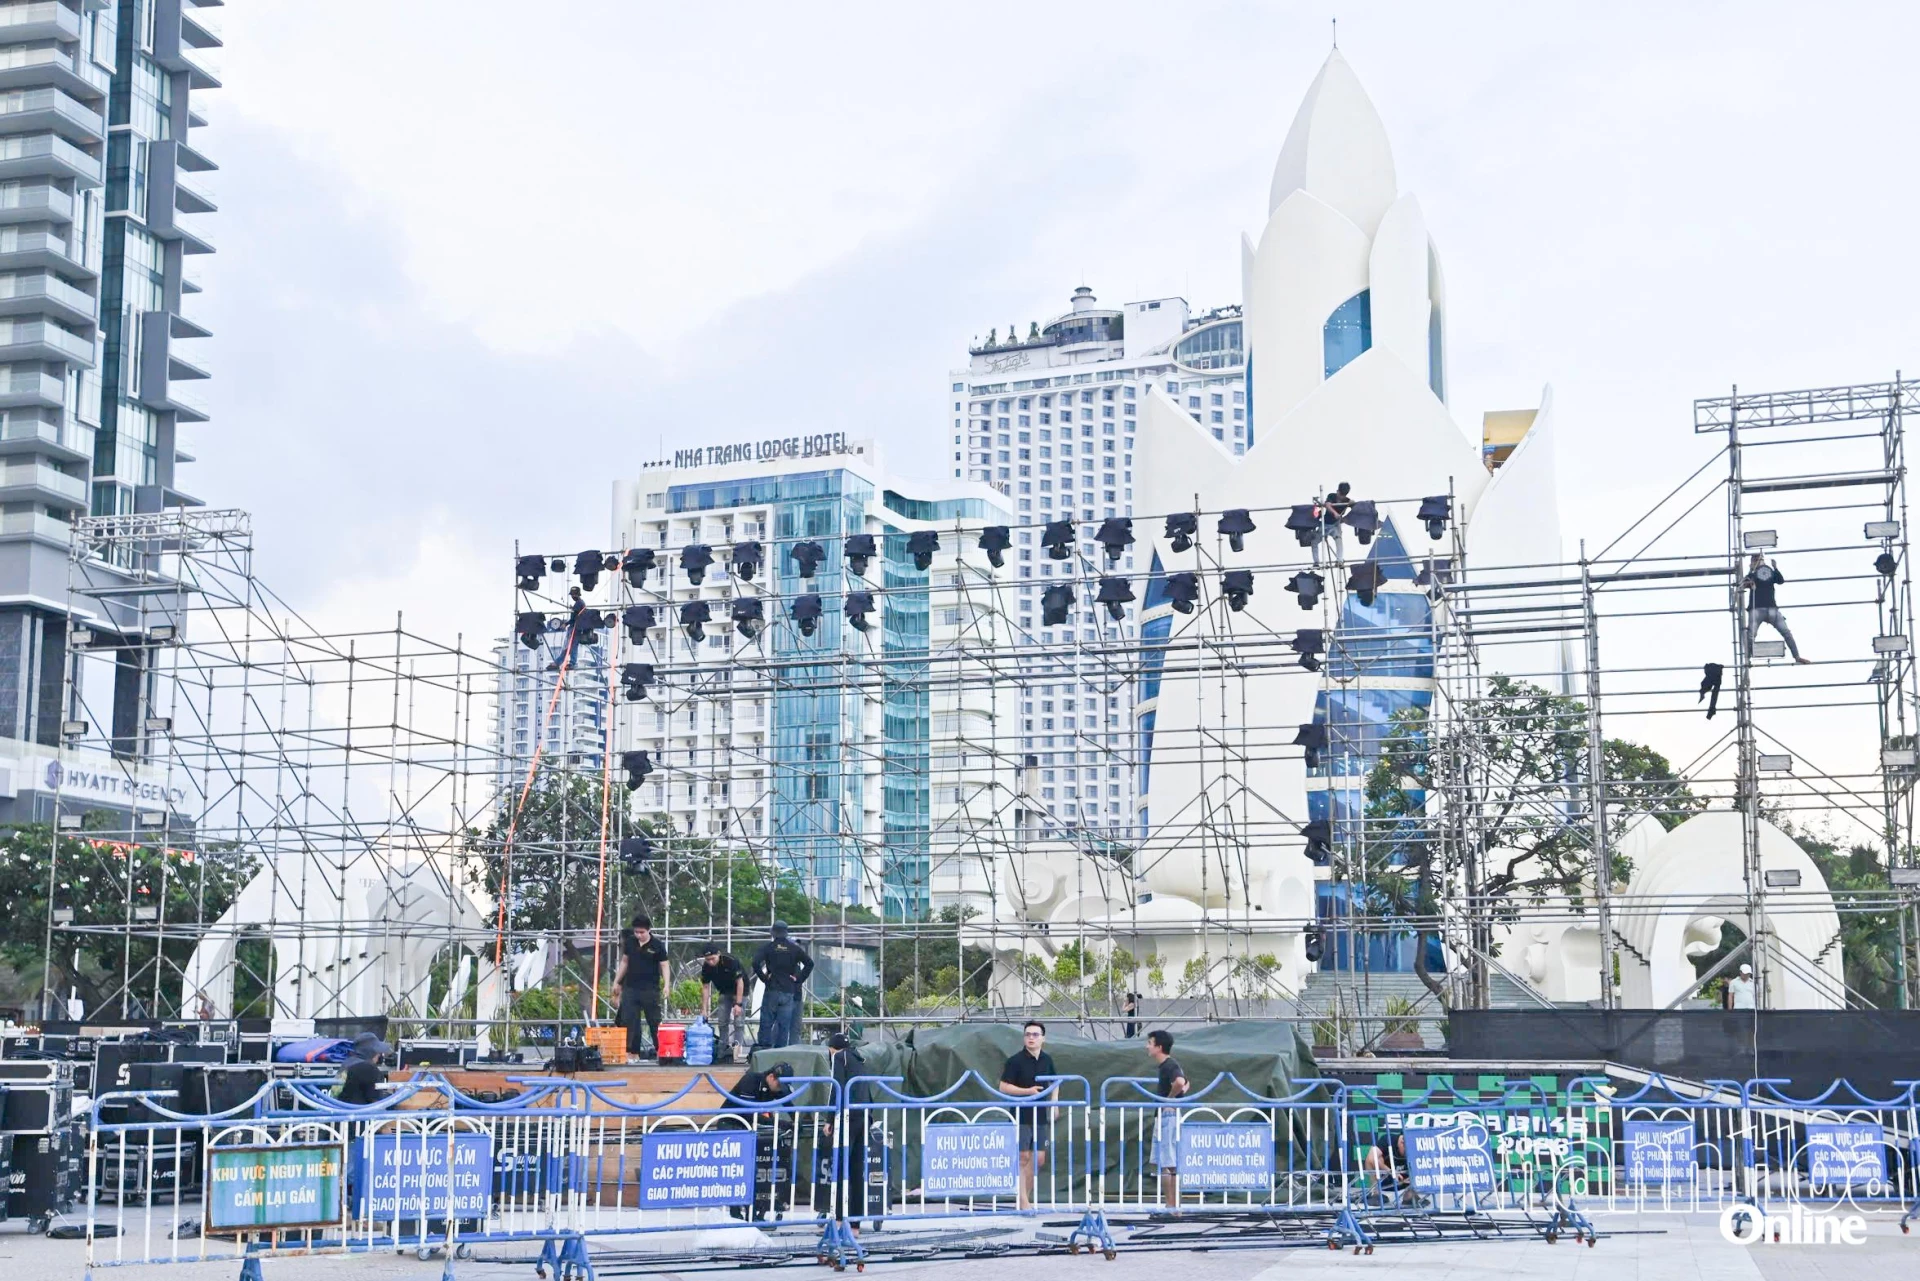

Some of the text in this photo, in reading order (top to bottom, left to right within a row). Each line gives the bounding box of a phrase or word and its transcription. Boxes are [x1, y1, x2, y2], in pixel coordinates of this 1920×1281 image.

[675, 431, 848, 469] NHA TRANG LODGE HOTEL
[68, 770, 187, 805] HYATT REGENCY
[937, 1130, 1005, 1152] KHU VỰC CẤM
[1191, 1135, 1211, 1148] KHU
[1238, 1130, 1261, 1148] CẤM
[1415, 1137, 1435, 1152] KHU
[657, 1137, 741, 1161] KHU VỰC CẤM
[931, 1154, 1010, 1170] CÁC PHƯƠNG TIỆN
[1186, 1152, 1265, 1168] CÁC PHƯƠNG TIỆN
[1415, 1155, 1433, 1169] CÁC
[212, 1157, 338, 1183] KHU VỰC NGUY HIỂM
[653, 1162, 744, 1180] CÁC PHƯƠNG TIỆN
[1183, 1174, 1200, 1185] GIAO
[1202, 1171, 1228, 1185] THÔNG
[1258, 1171, 1268, 1187] BỘ
[375, 1172, 398, 1189] CÁC
[455, 1171, 481, 1189] TIỆN
[928, 1172, 1014, 1189] GIAO THÔNG ĐƯỜNG BỘ
[1415, 1175, 1431, 1187] GIAO
[234, 1187, 263, 1207] CẤM
[266, 1190, 286, 1208] LẠI
[647, 1182, 747, 1200] GIAO THÔNG ĐƯỜNG BỘ
[371, 1197, 396, 1211] GIAO
[470, 1192, 483, 1211] BỘ
